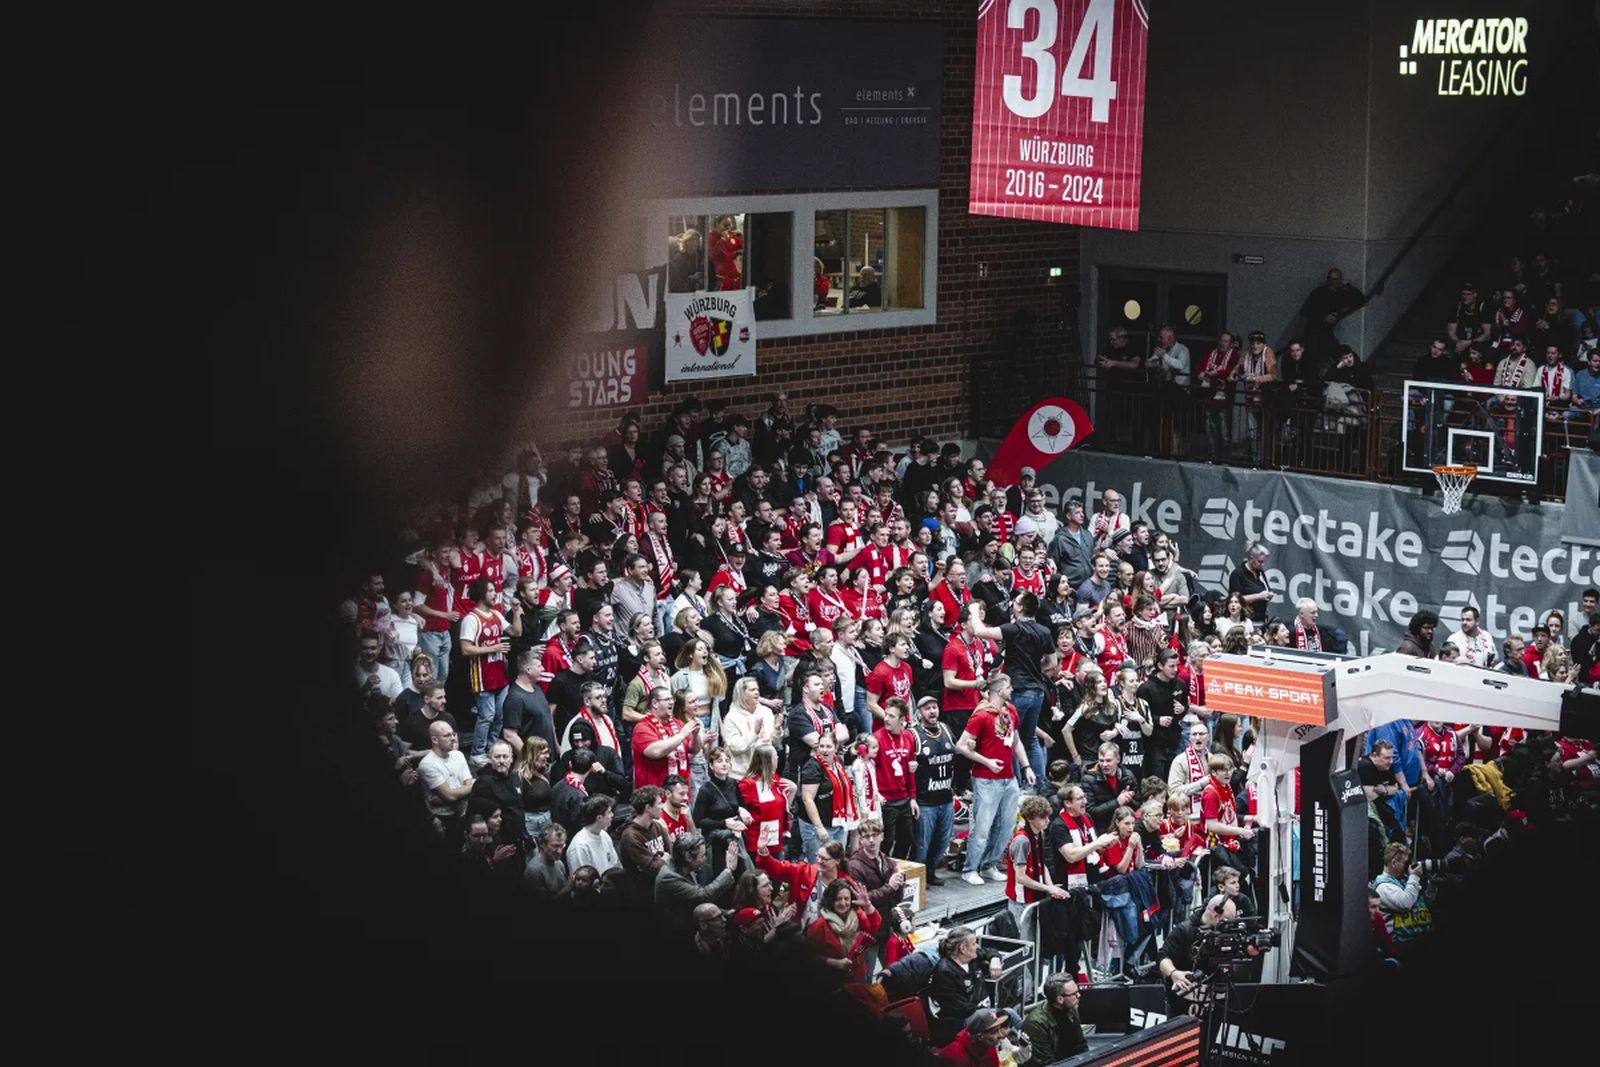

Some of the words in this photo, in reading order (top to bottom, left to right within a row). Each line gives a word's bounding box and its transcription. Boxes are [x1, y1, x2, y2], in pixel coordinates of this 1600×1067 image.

[1411, 17, 1528, 54] MERCATOR
[1002, 0, 1117, 124] 34
[1438, 59, 1528, 96] LEASING
[856, 87, 904, 101] elements
[1019, 136, 1094, 168] WÜRZBURG
[1005, 169, 1045, 198] 2016
[1062, 174, 1104, 205] 2024
[684, 296, 737, 320] WÜRZBURG
[680, 354, 742, 373] international
[568, 376, 632, 407] STARS
[1243, 499, 1423, 568] tectake
[1224, 682, 1264, 697] PEAK
[1268, 688, 1320, 705] SPORT
[1129, 741, 1139, 753] 32
[938, 764, 947, 778] 11
[1312, 800, 1326, 902] spindler
